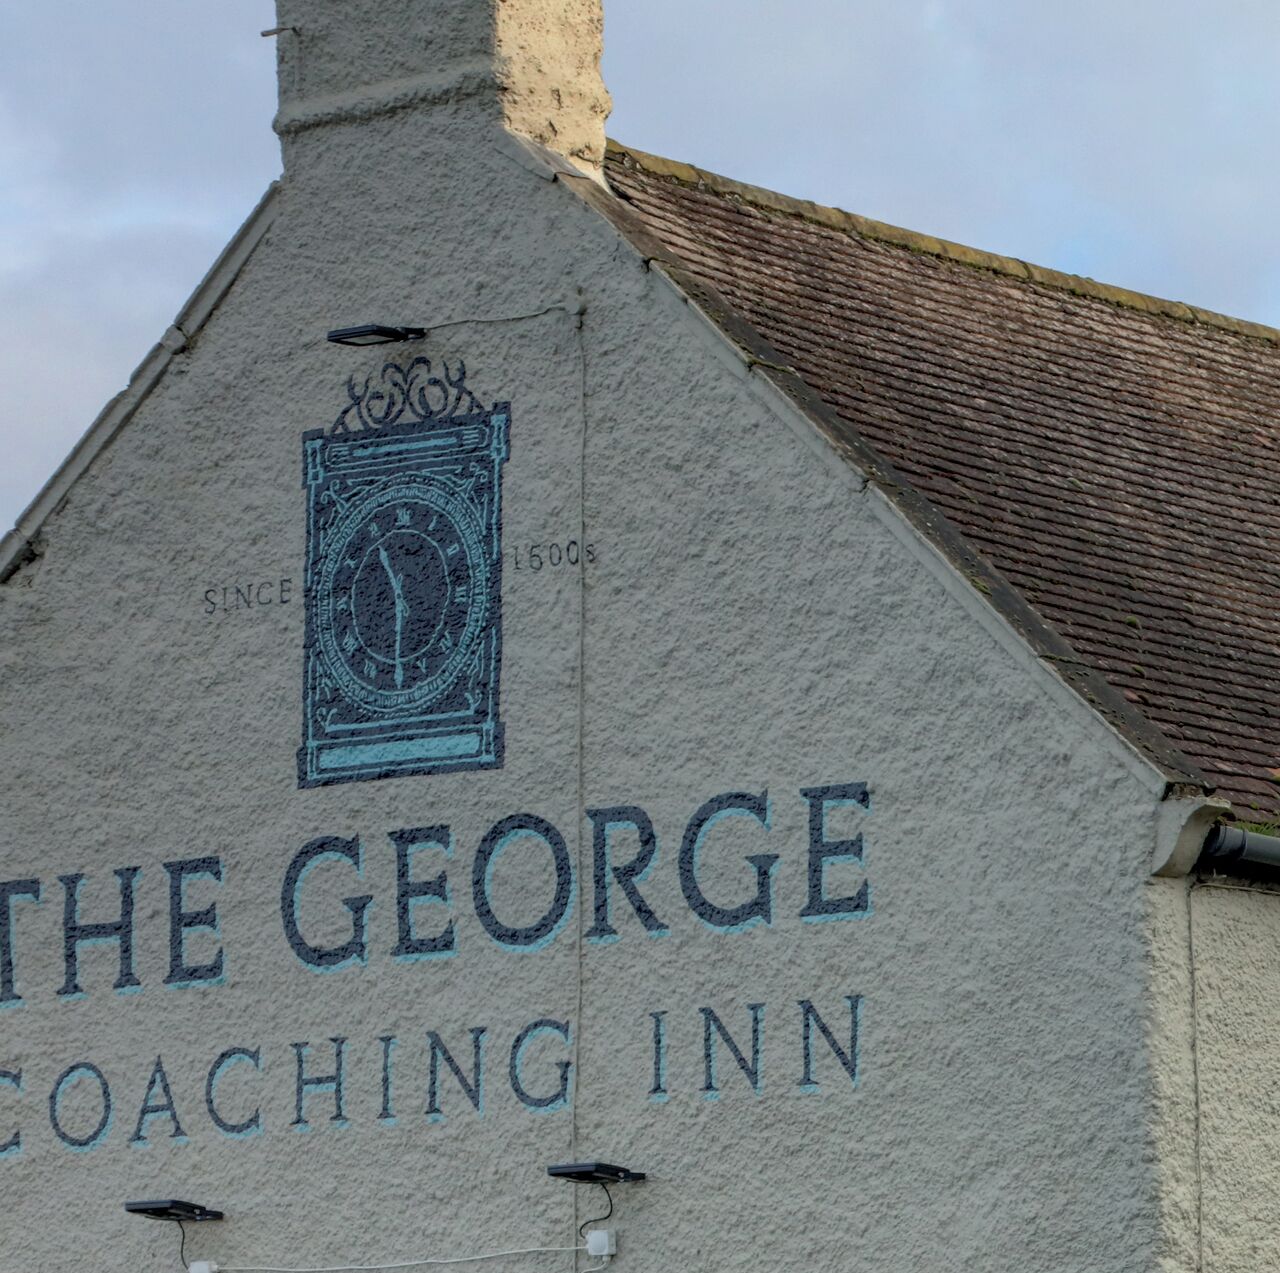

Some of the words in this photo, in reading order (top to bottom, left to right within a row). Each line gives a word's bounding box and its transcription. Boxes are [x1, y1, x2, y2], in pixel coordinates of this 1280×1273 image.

[204, 578, 292, 614] SINCE
[511, 541, 596, 571] 1500s
[281, 782, 872, 971] GEORGE
[648, 995, 866, 1101] INN
